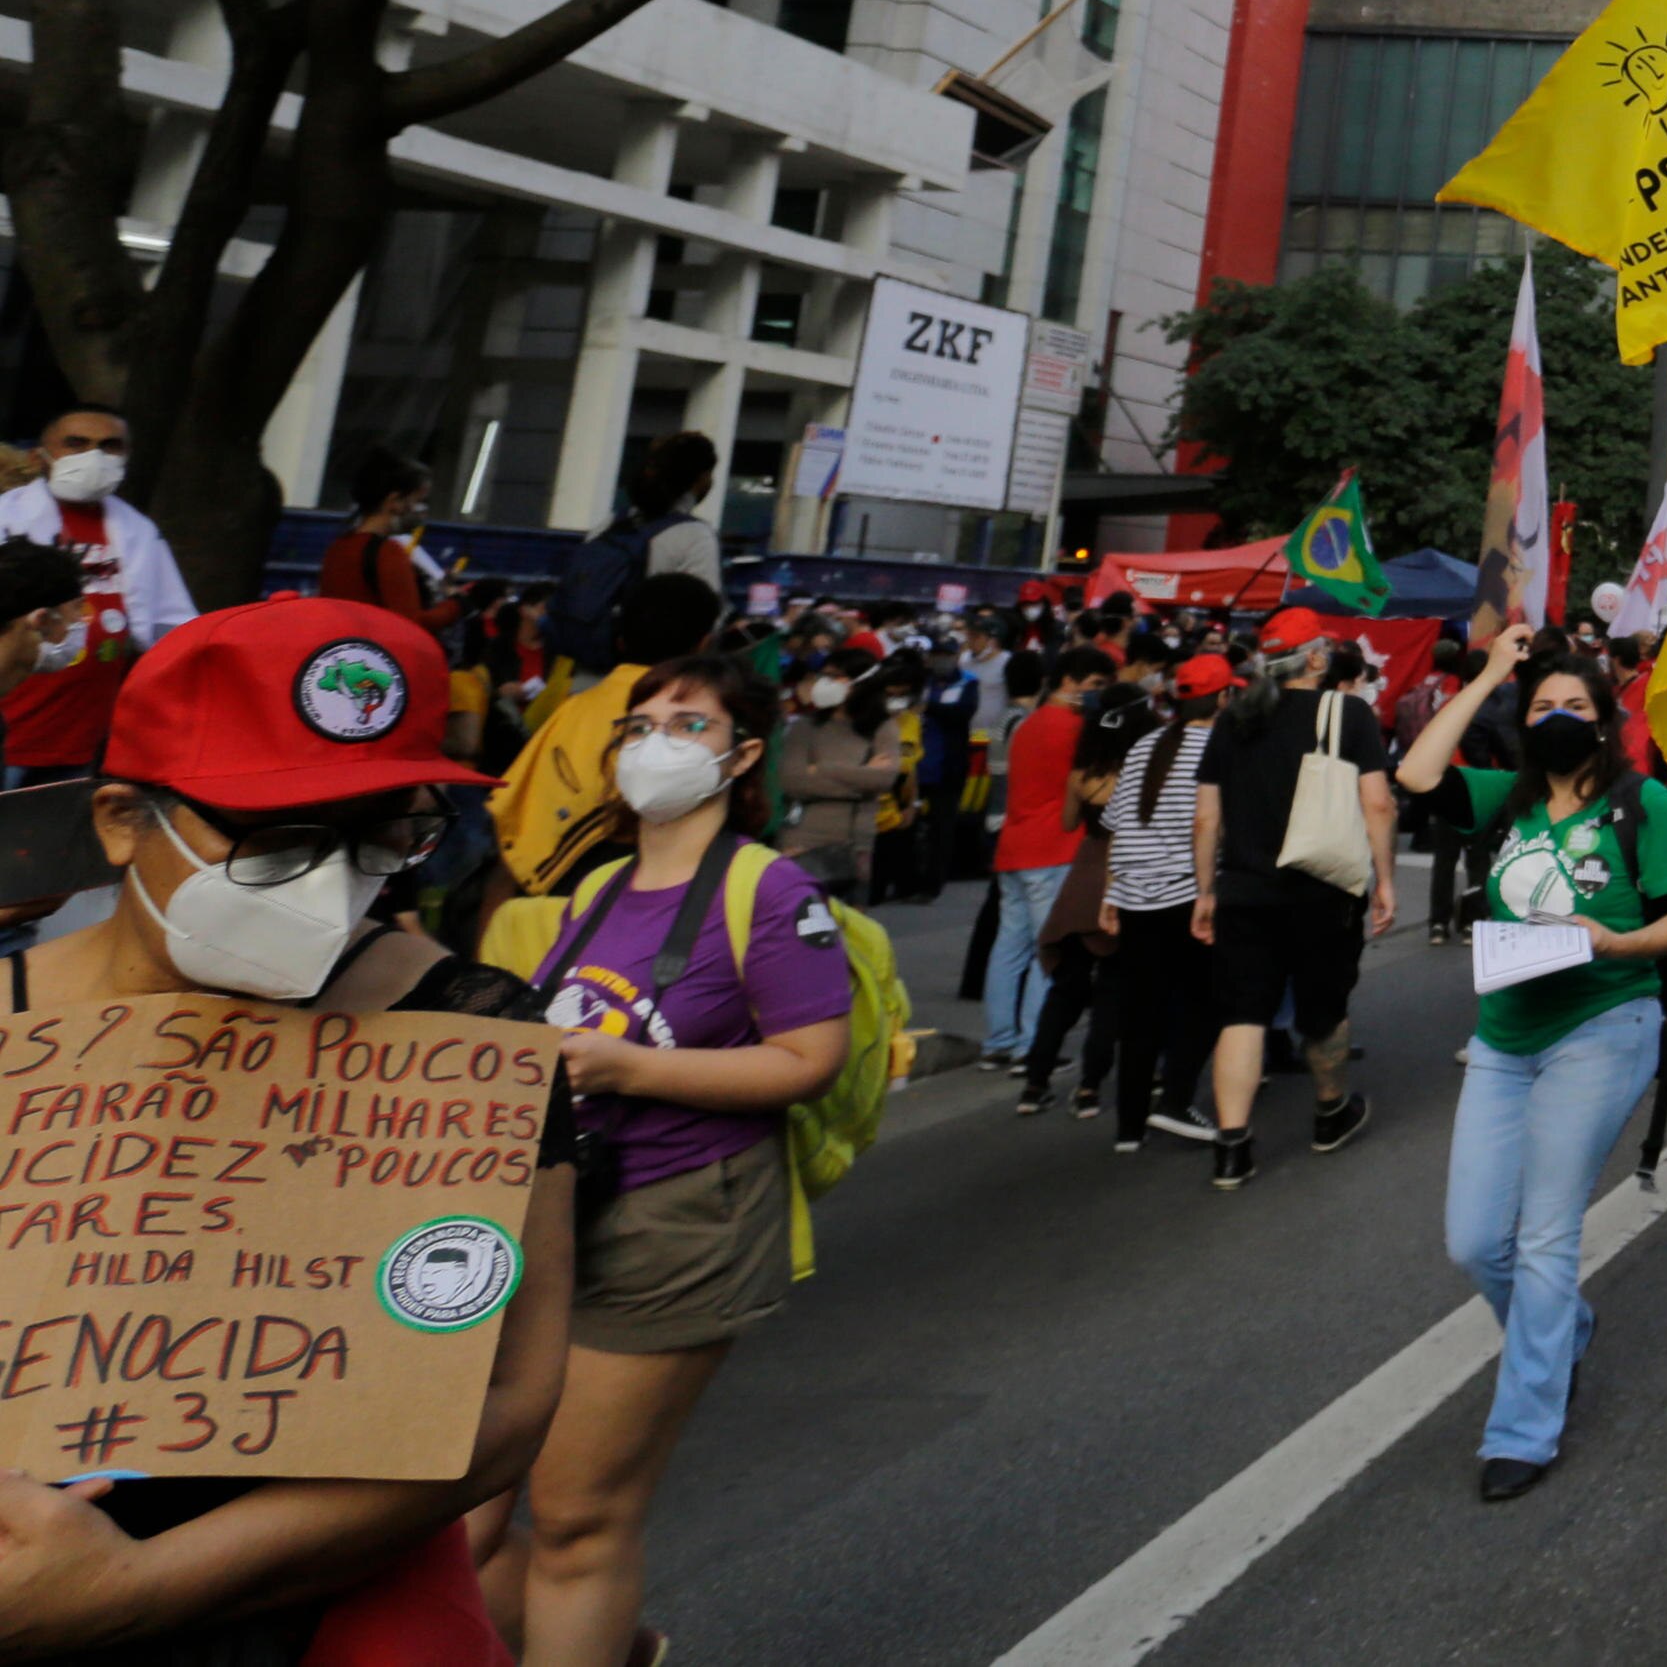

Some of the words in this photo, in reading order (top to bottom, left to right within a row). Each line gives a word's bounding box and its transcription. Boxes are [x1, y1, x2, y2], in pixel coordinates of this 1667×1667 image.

[904, 310, 994, 366] ZKF
[138, 1010, 277, 1071] SÃO
[7, 1070, 218, 1134] FARÃO
[67, 1249, 196, 1288] HILDA
[231, 1248, 365, 1289] HILST
[0, 1310, 351, 1400] ENOCIDA
